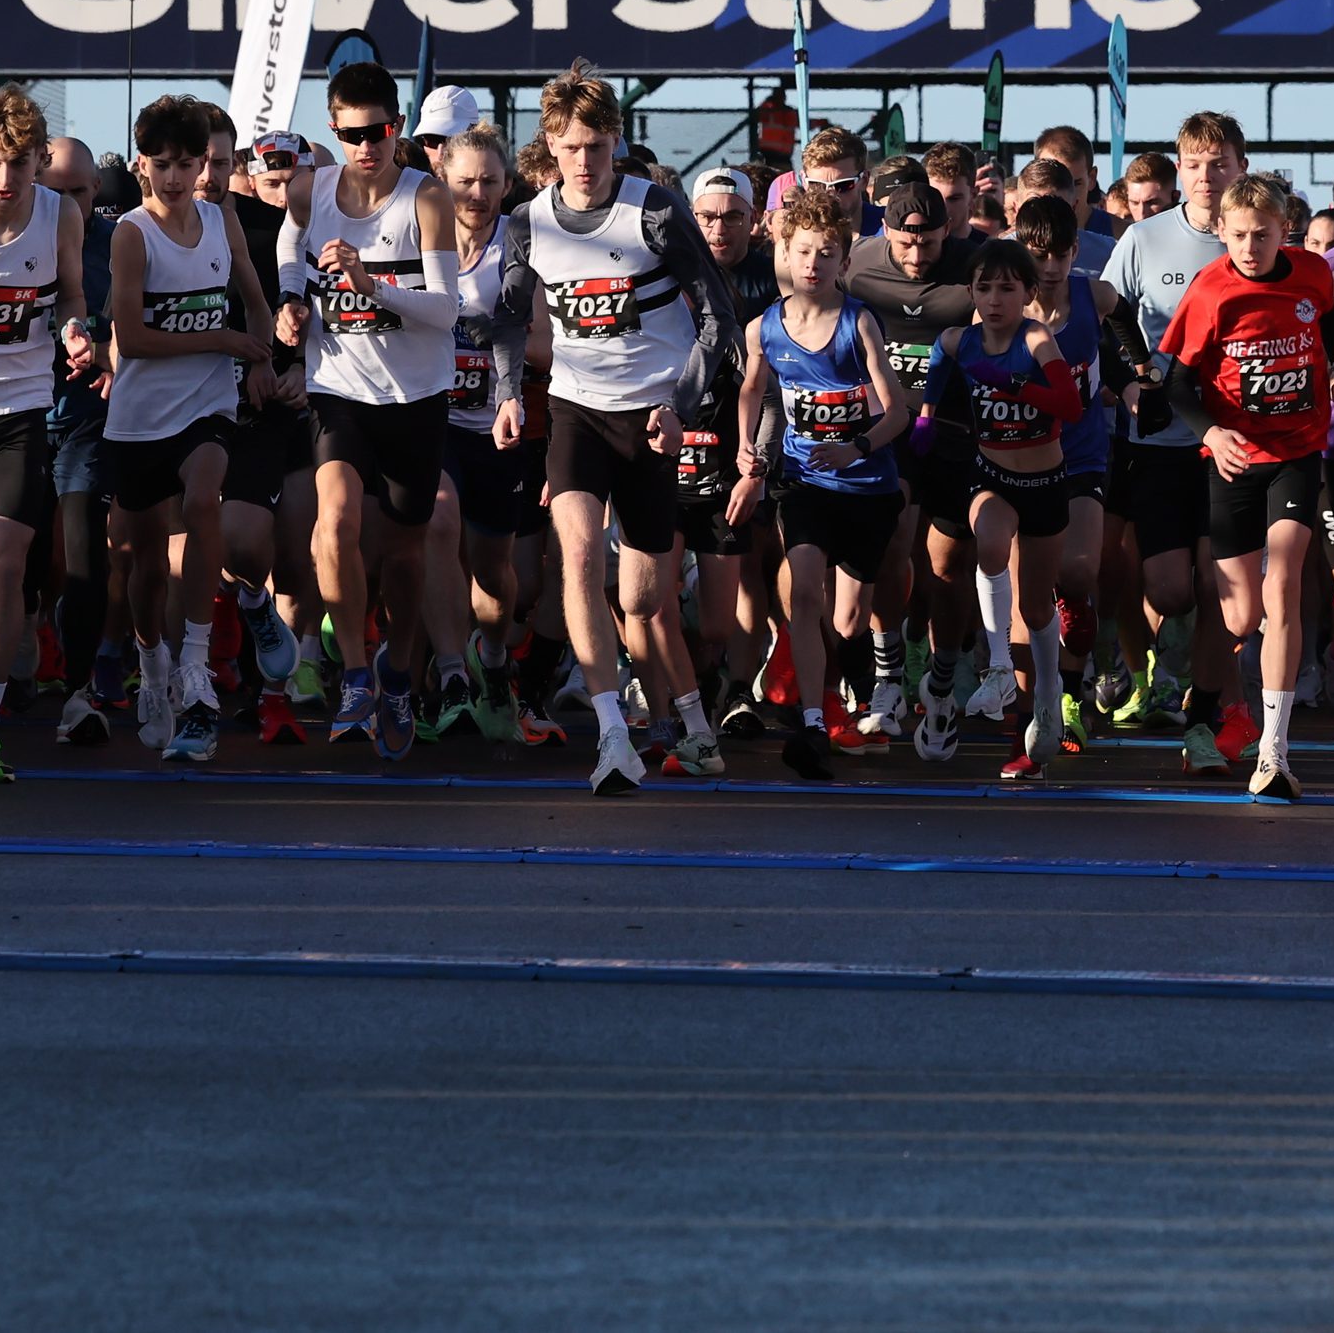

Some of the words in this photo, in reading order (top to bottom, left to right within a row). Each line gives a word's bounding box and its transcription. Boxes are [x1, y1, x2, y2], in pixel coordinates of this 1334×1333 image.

[610, 277, 630, 290] 5K
[1161, 272, 1186, 286] OB
[14, 290, 32, 300] 5K
[203, 294, 223, 306] 10K
[327, 291, 382, 312] 700
[563, 292, 629, 318] 7027
[160, 309, 223, 333] 4082
[467, 357, 485, 367] 5K
[452, 370, 482, 389] 08
[1249, 369, 1308, 395] 7023
[847, 388, 863, 401] 5K
[800, 402, 864, 424] 7022
[695, 433, 713, 443] 5K
[999, 473, 1050, 488] UNDER
